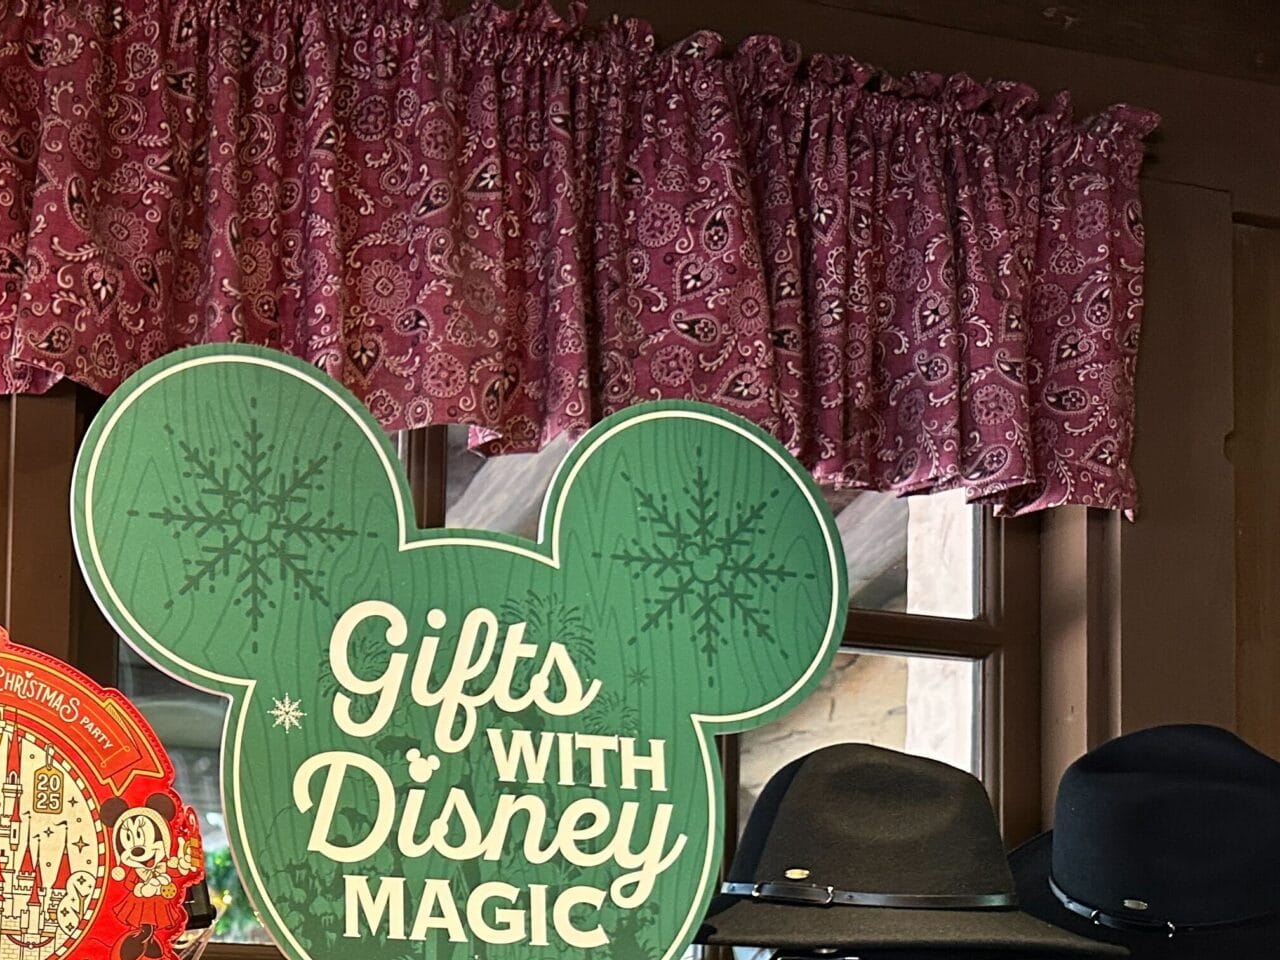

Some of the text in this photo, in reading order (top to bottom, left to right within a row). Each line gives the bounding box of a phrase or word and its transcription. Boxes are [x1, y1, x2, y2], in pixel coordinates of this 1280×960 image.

[328, 600, 603, 754] Gifts
[80, 717, 114, 751] PARTY
[486, 728, 668, 792] WITH
[37, 792, 60, 810] 25
[38, 774, 60, 791] 20
[292, 748, 688, 909] Disney
[342, 874, 610, 948] MAGIC
